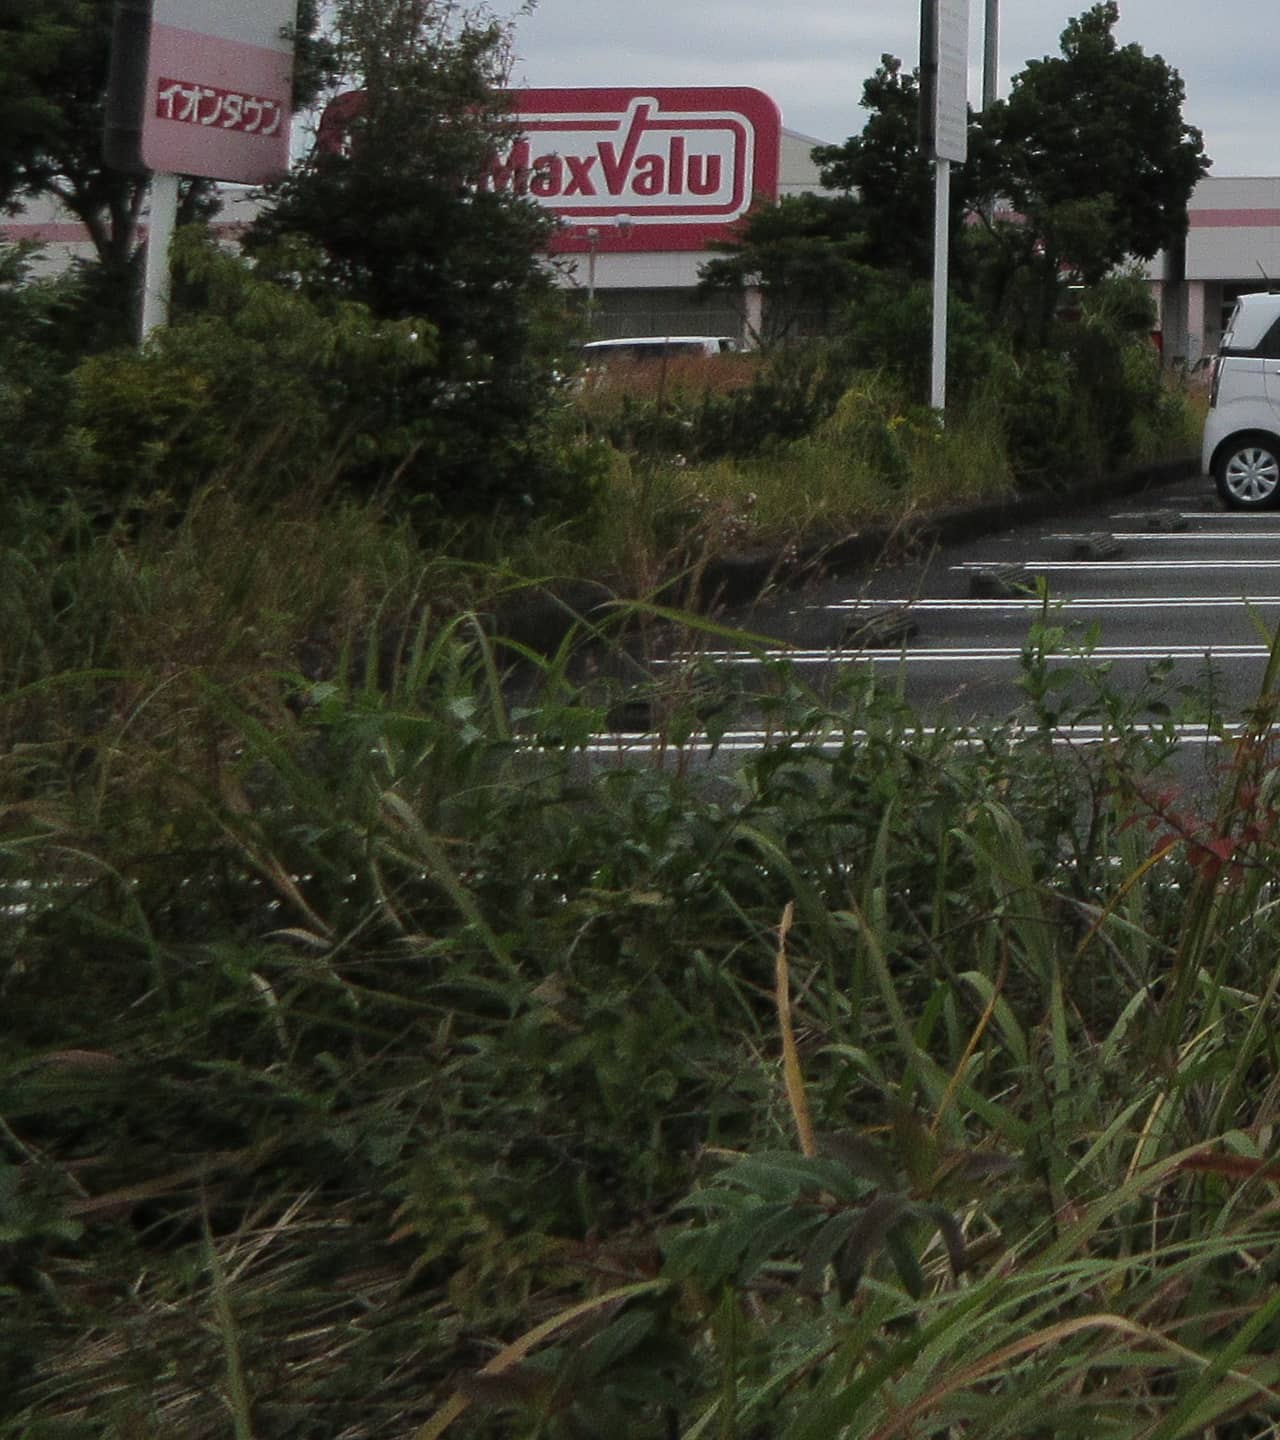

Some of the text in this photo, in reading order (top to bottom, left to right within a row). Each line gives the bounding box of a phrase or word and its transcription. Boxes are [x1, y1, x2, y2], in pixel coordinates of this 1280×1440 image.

[159, 84, 281, 135] イオンタウン
[483, 104, 721, 197] MaxValu
